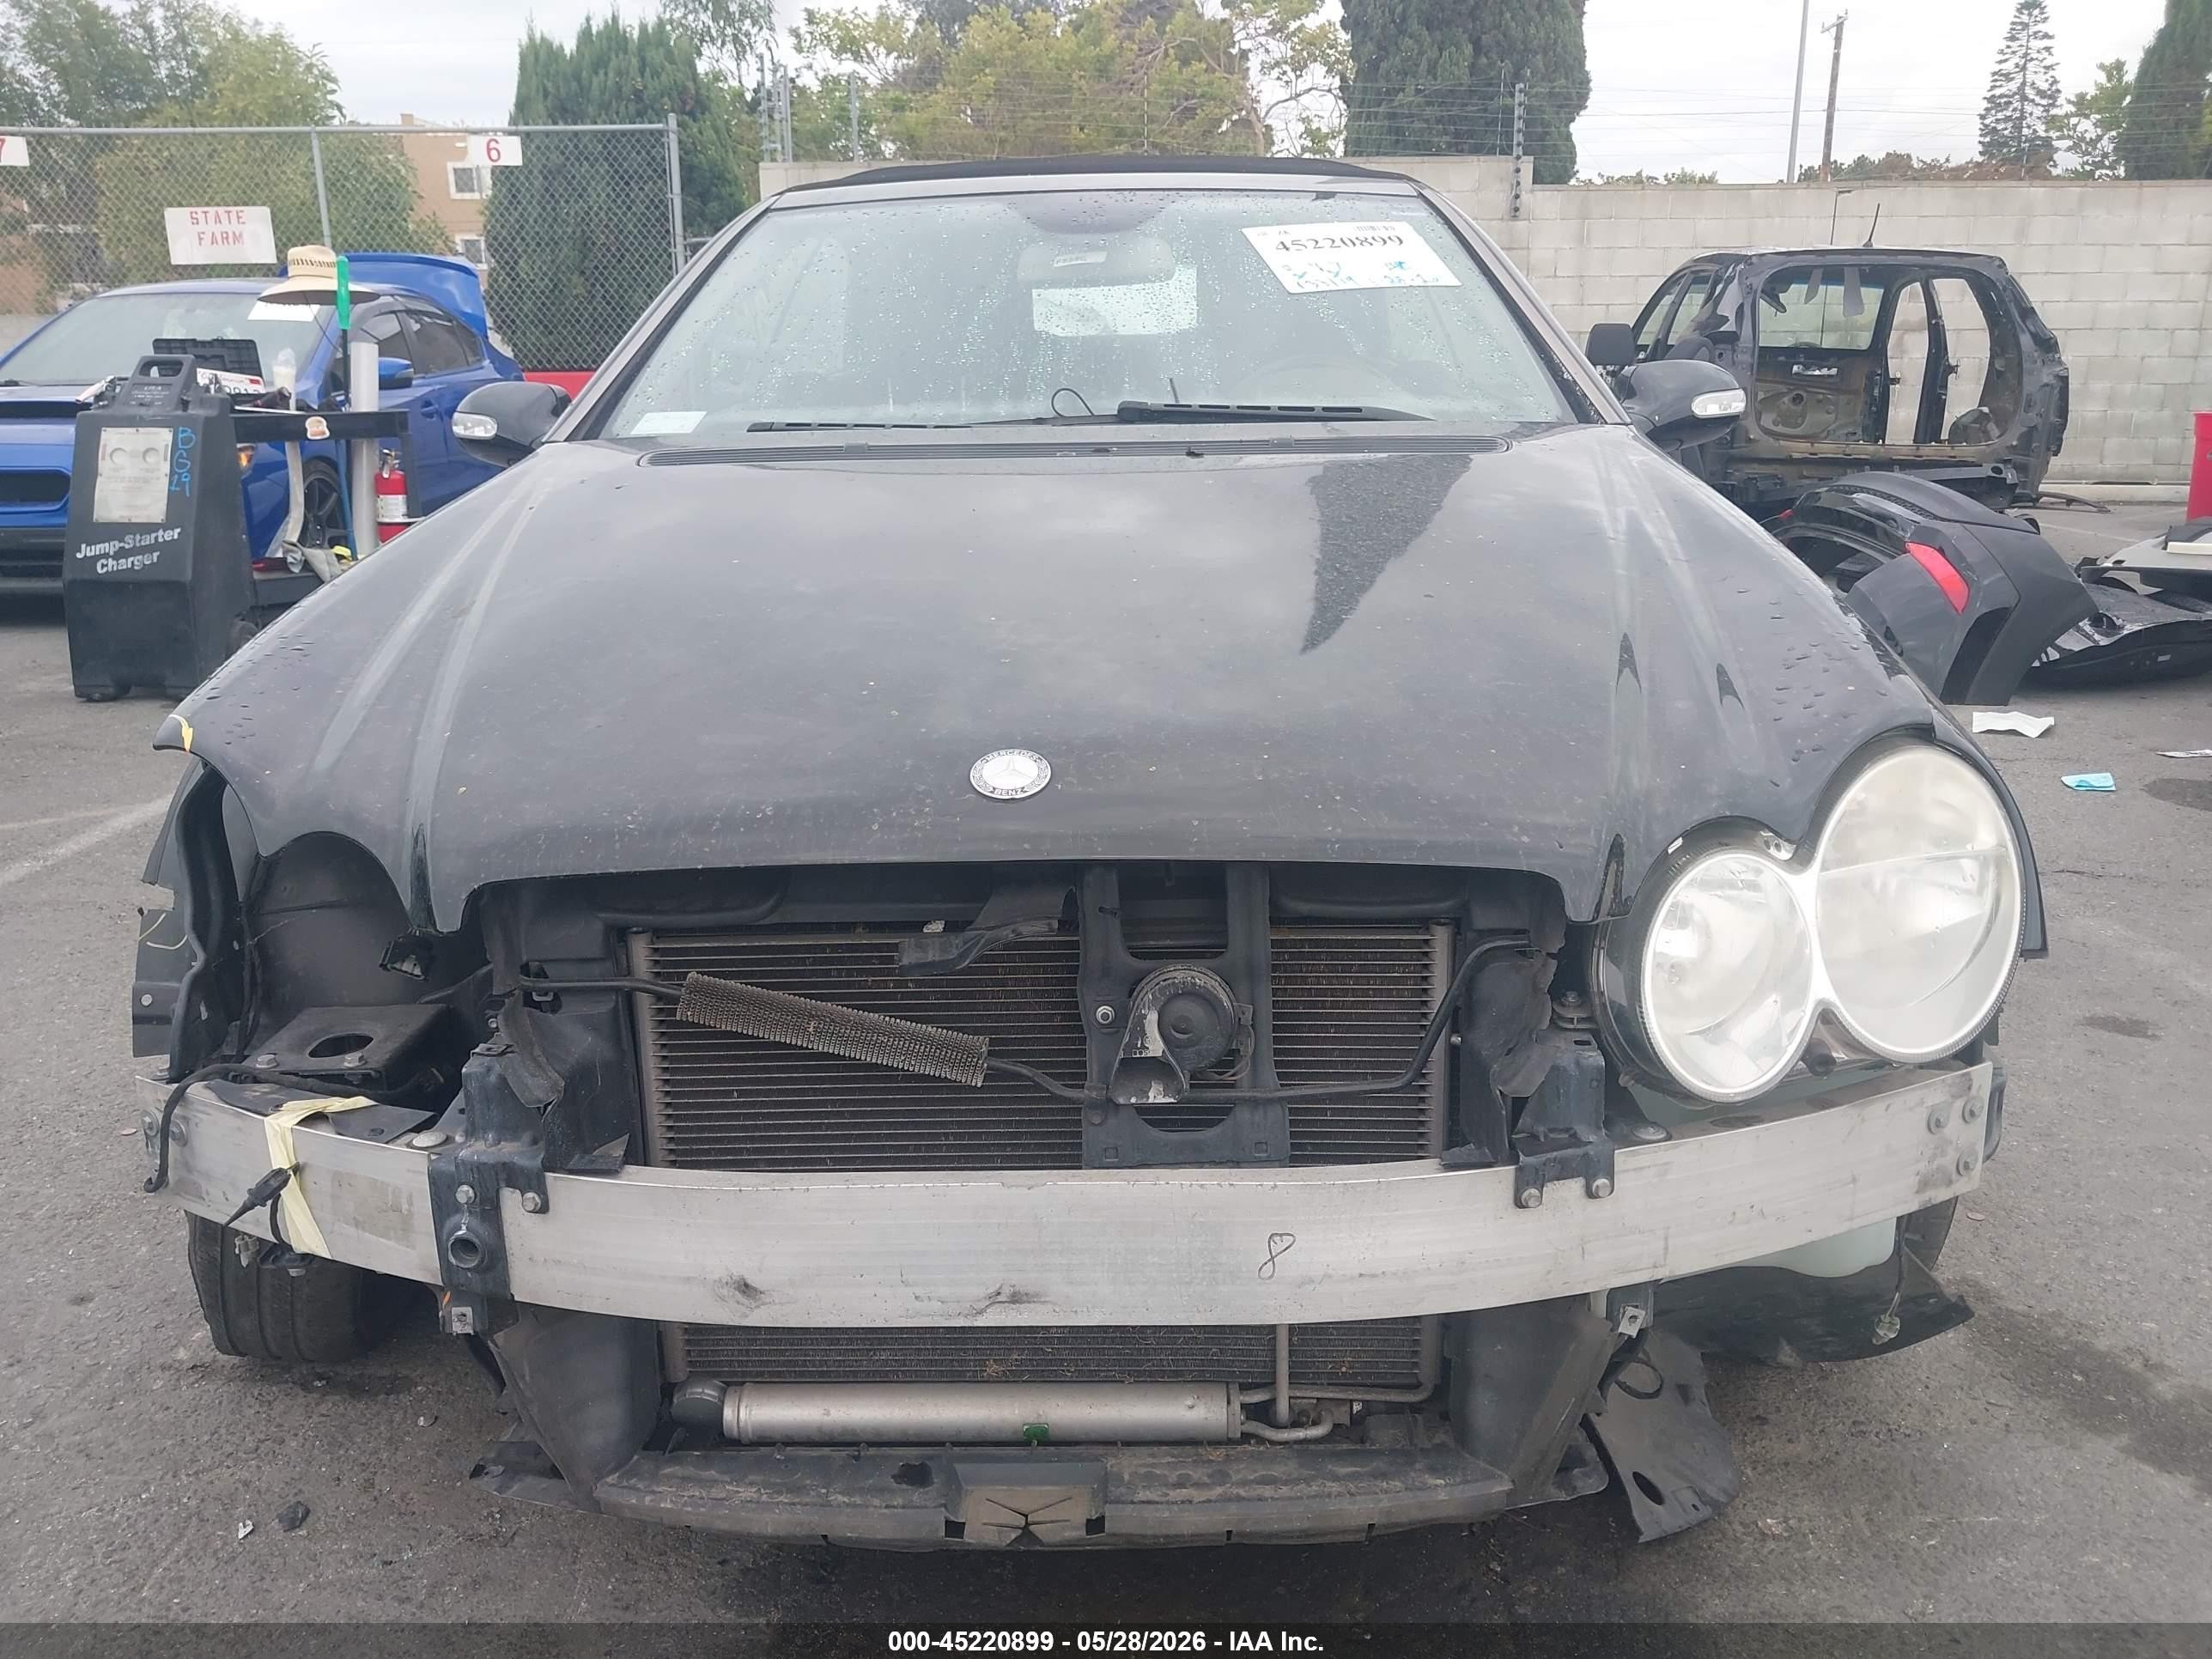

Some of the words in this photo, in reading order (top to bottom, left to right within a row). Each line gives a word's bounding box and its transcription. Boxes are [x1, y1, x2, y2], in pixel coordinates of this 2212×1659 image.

[486, 138, 501, 163] 6
[190, 210, 246, 225] STATE
[198, 231, 245, 246] FARM
[1276, 234, 1404, 251] 45220899
[76, 527, 182, 559] Jump-Starter
[96, 551, 161, 574] Charger
